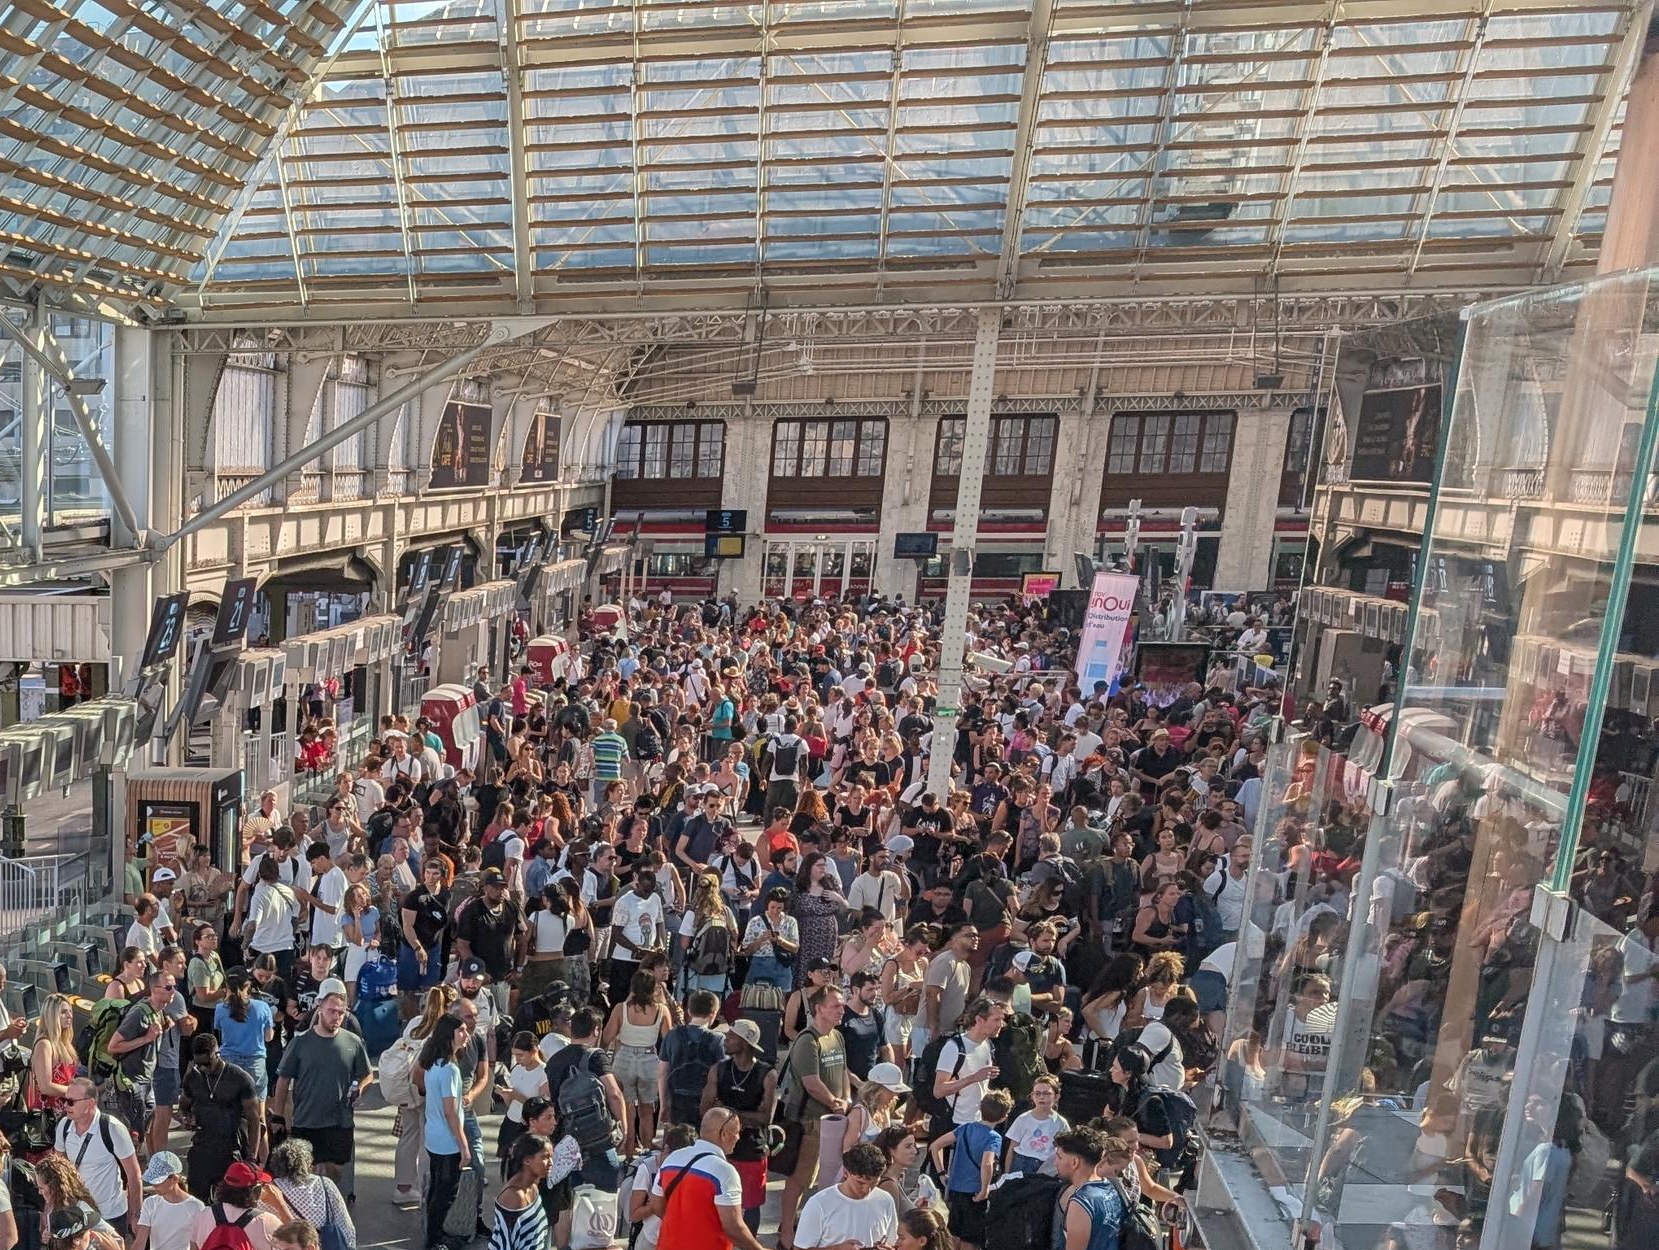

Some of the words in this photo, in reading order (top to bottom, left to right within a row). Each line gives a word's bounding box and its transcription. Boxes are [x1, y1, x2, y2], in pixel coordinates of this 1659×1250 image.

[722, 517, 730, 527] 5
[229, 600, 245, 627] 21
[1088, 613, 1128, 622] Distribution
[160, 618, 176, 648] 23
